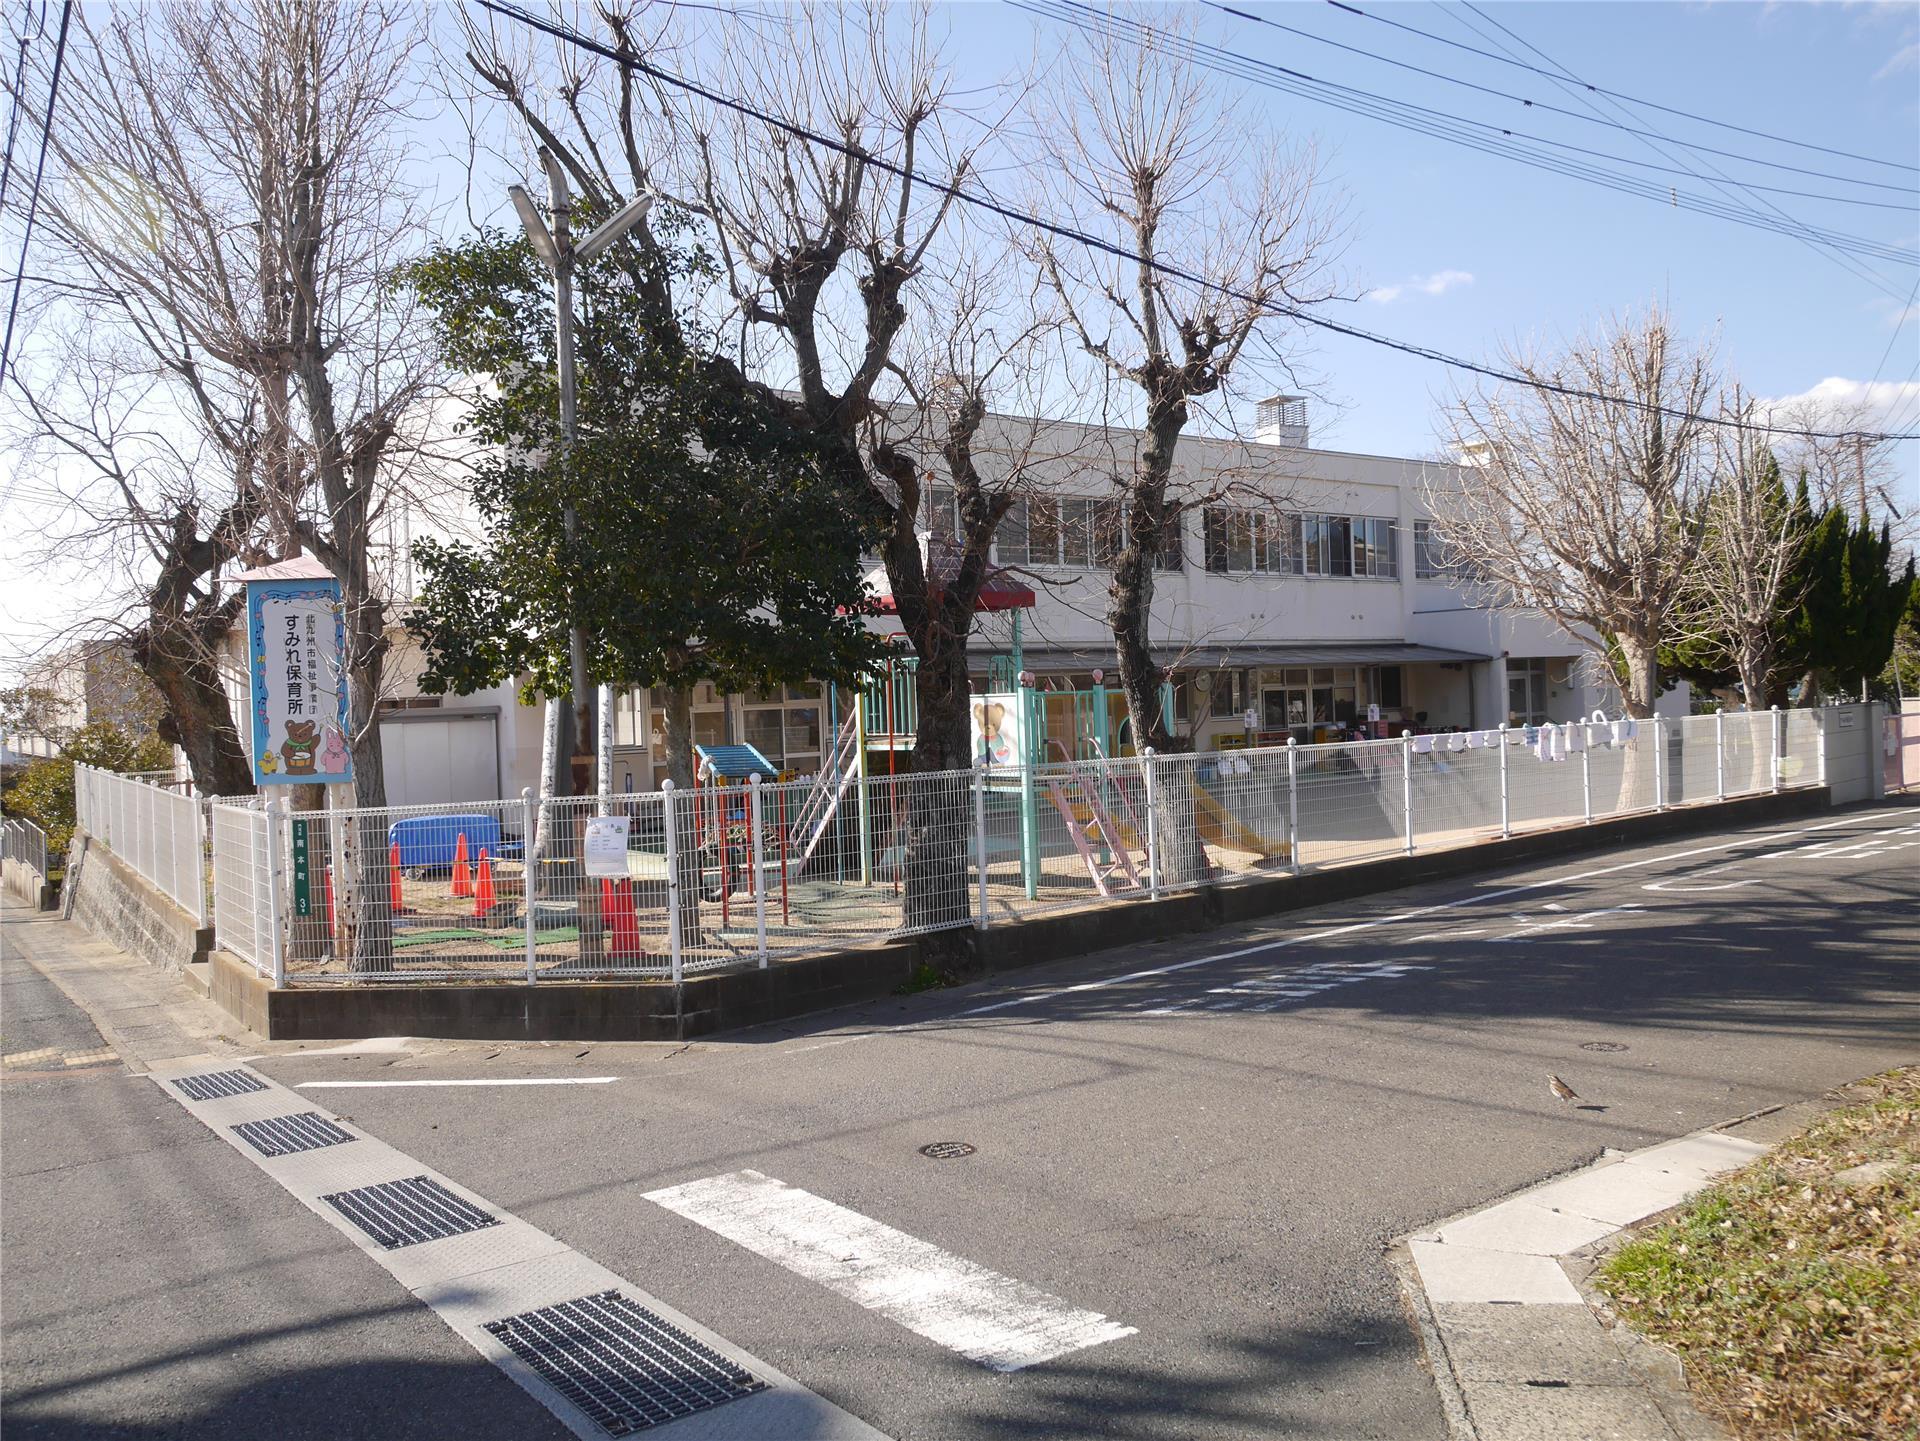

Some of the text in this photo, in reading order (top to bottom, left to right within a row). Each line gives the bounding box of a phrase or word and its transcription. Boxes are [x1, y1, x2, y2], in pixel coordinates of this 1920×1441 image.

[284, 614, 303, 715] すみれ保育所
[296, 839, 306, 881] 南本町
